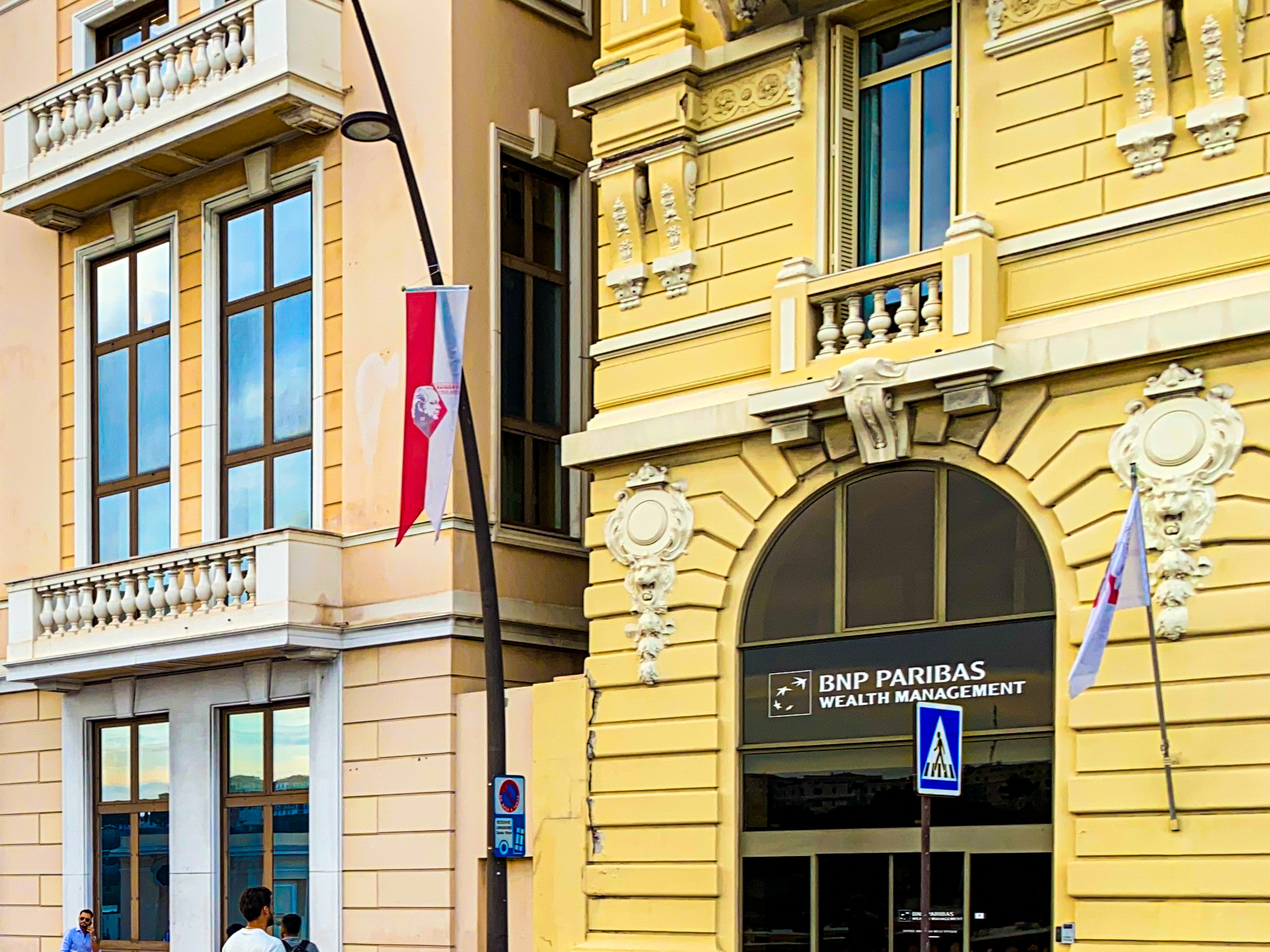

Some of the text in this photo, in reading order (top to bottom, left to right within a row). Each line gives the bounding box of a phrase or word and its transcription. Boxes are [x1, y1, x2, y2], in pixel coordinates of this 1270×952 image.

[819, 660, 986, 693] BNP PARIBAS
[819, 680, 1027, 709] WEALTH MANAGEMENT
